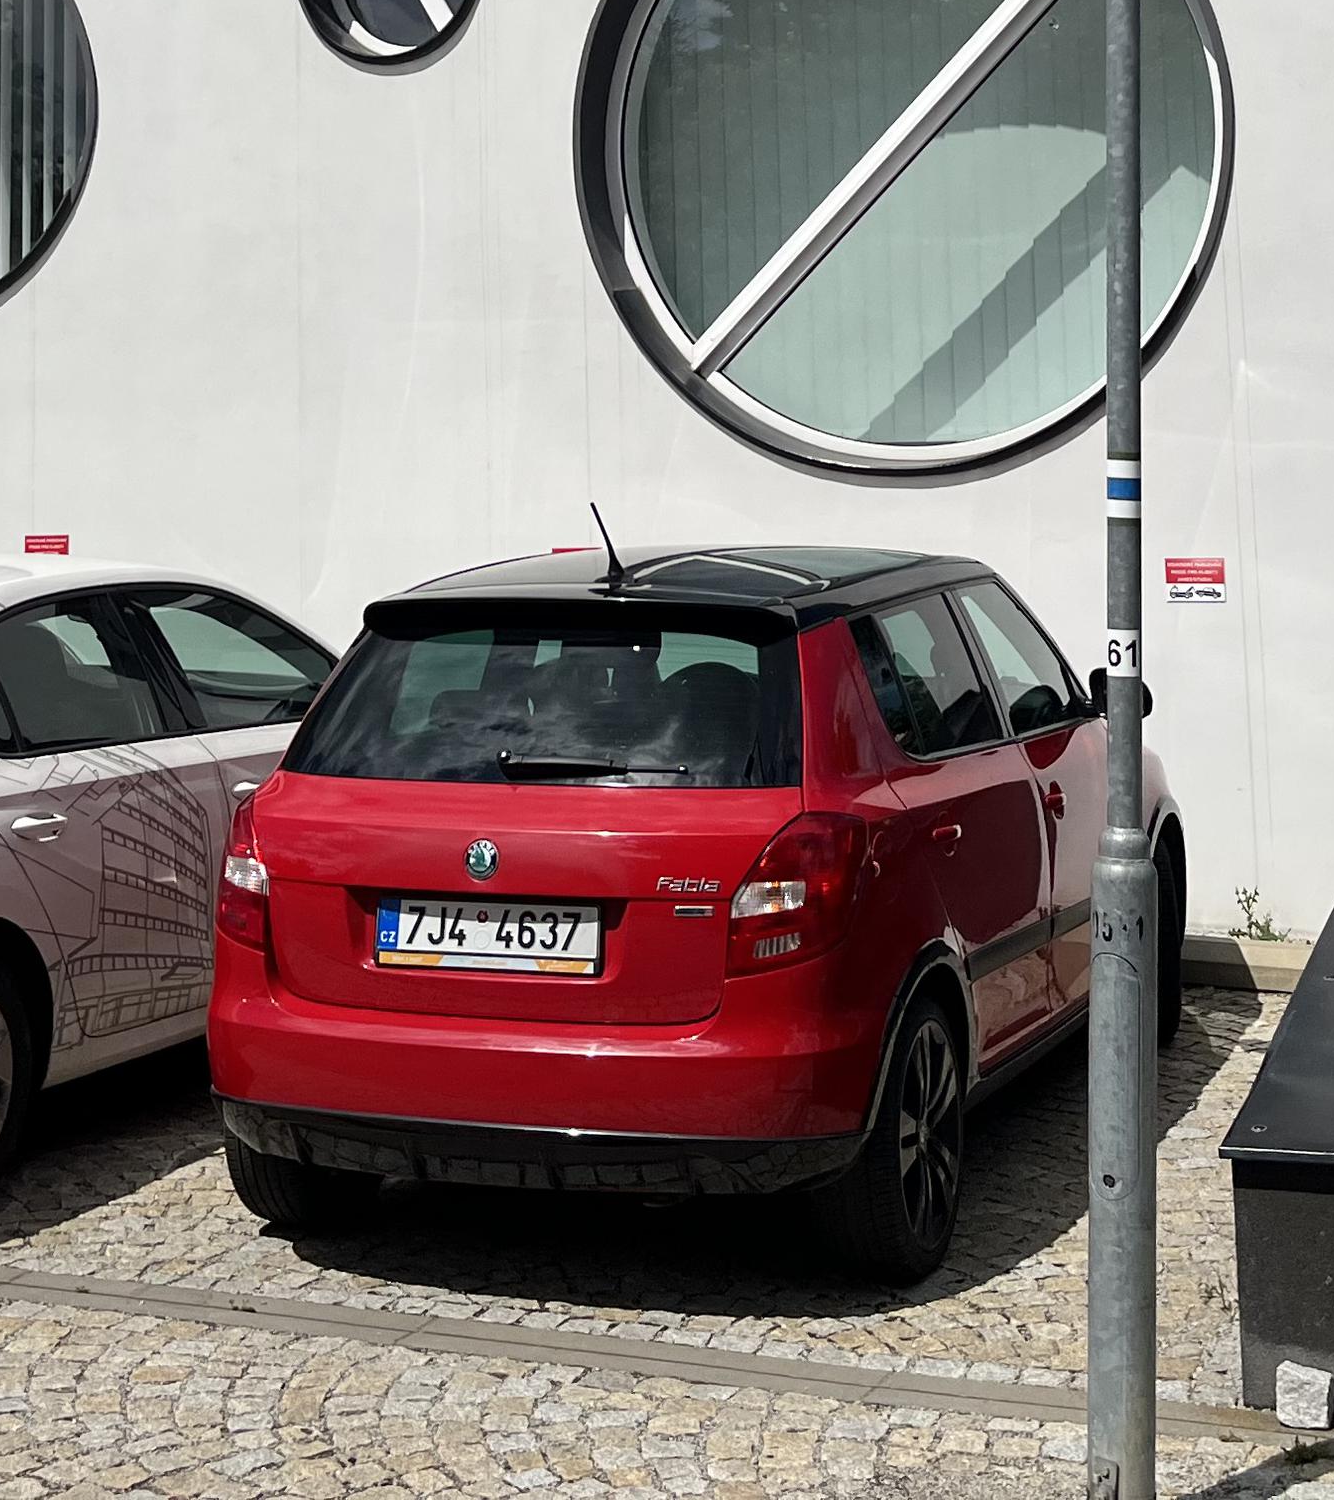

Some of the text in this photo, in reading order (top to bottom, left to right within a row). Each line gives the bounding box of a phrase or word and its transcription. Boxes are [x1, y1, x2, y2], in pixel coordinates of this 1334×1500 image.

[1107, 639, 1138, 668] 61
[656, 876, 722, 893] Fabia
[380, 931, 396, 944] CZ
[406, 905, 582, 951] 7J4 4637
